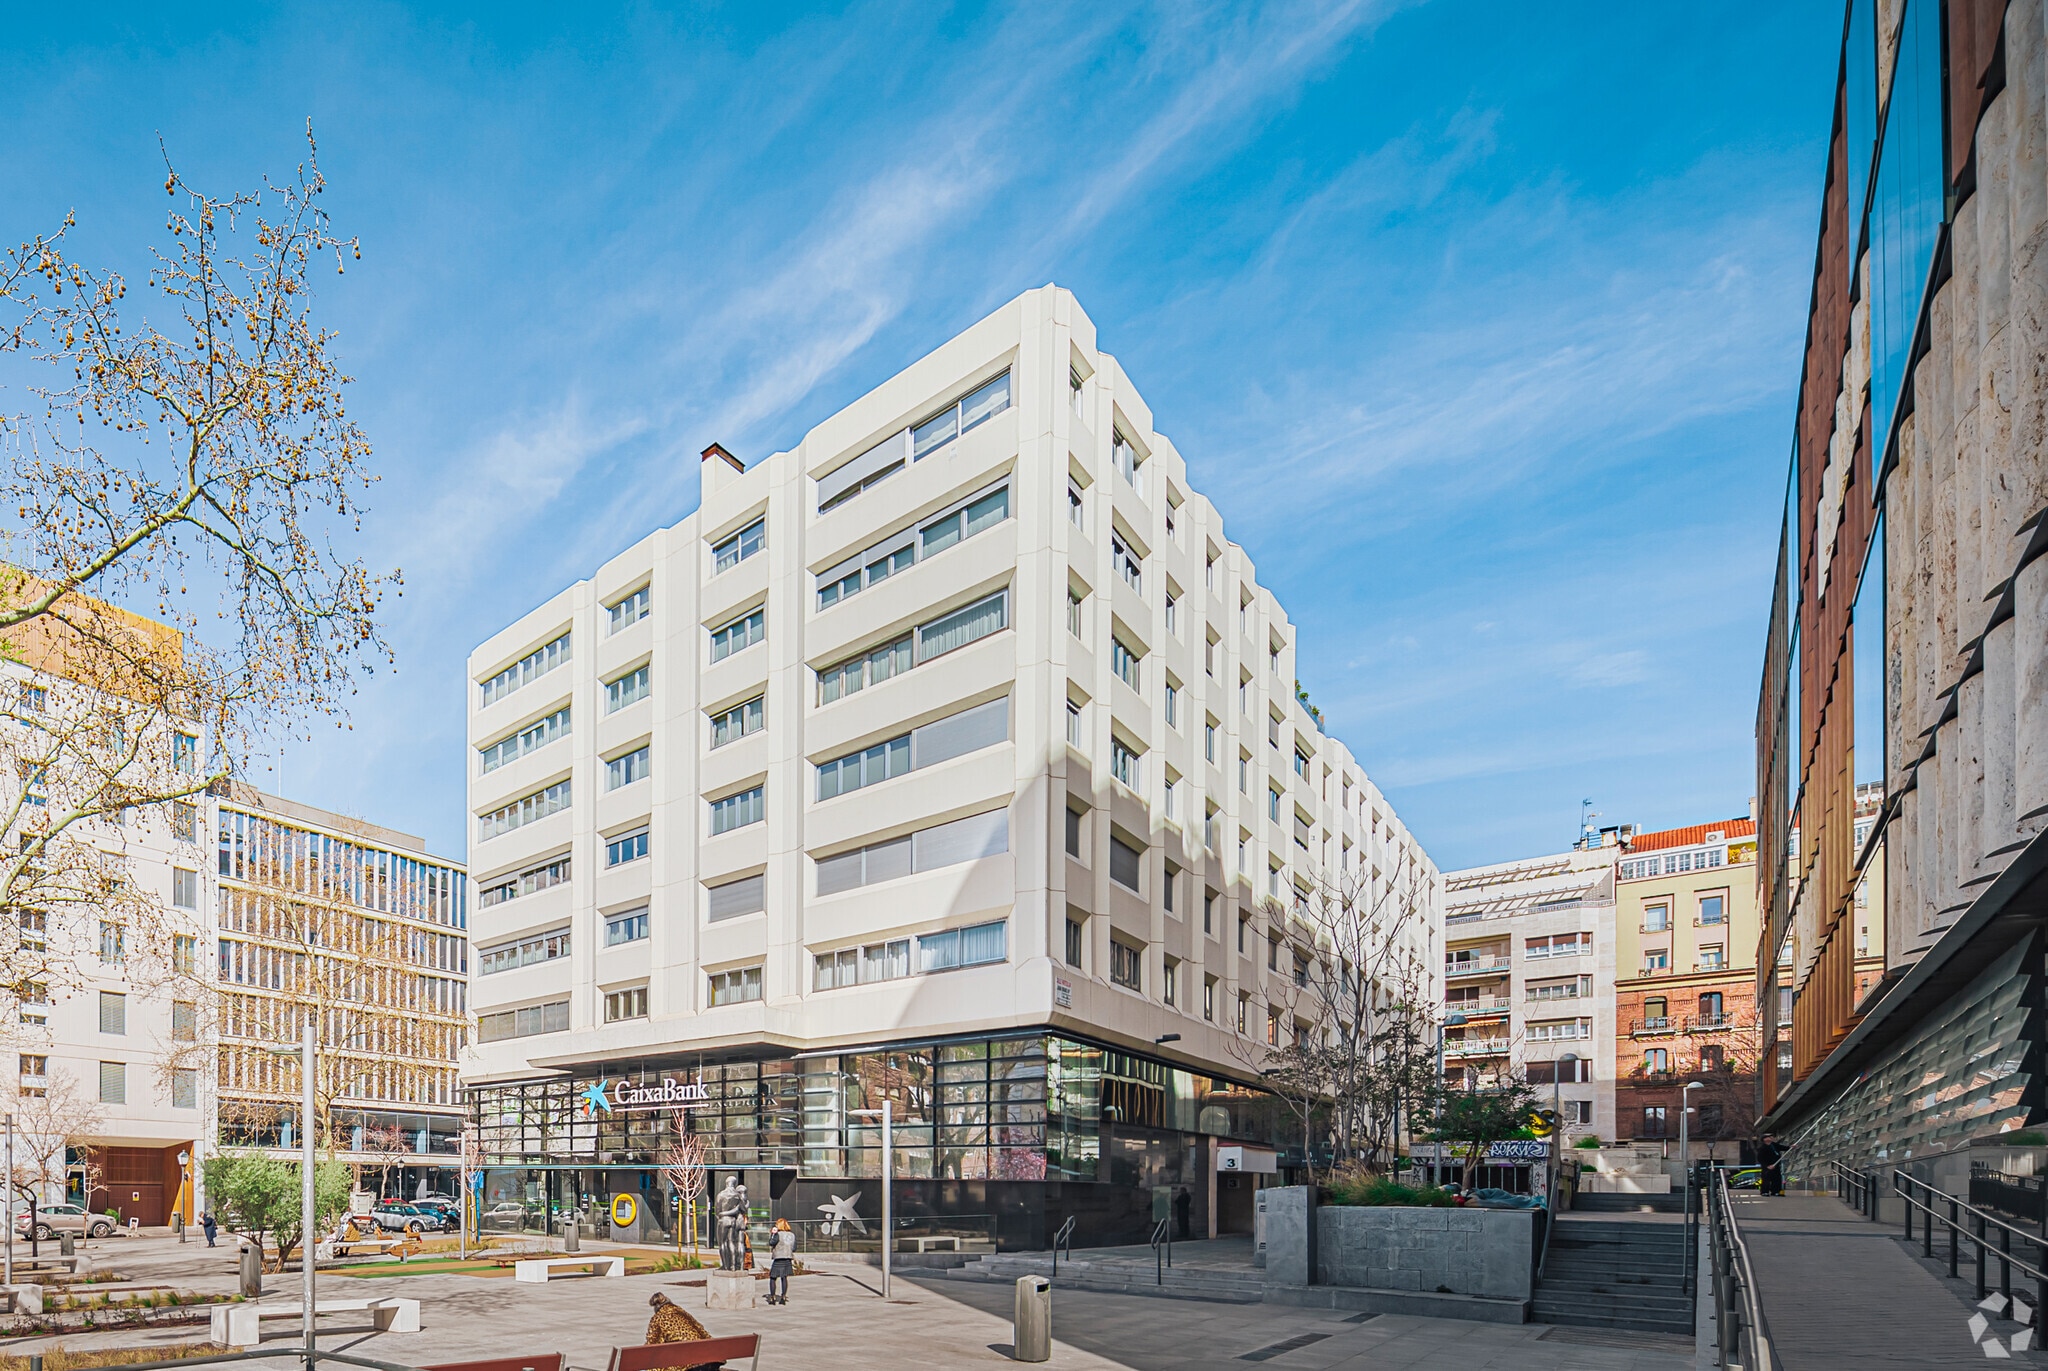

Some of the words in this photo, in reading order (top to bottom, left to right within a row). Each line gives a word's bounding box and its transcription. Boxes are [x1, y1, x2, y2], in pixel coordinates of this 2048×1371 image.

[614, 1075, 709, 1105] CaixaBank
[1227, 1158, 1236, 1167] 3
[1229, 1179, 1237, 1188] 3
